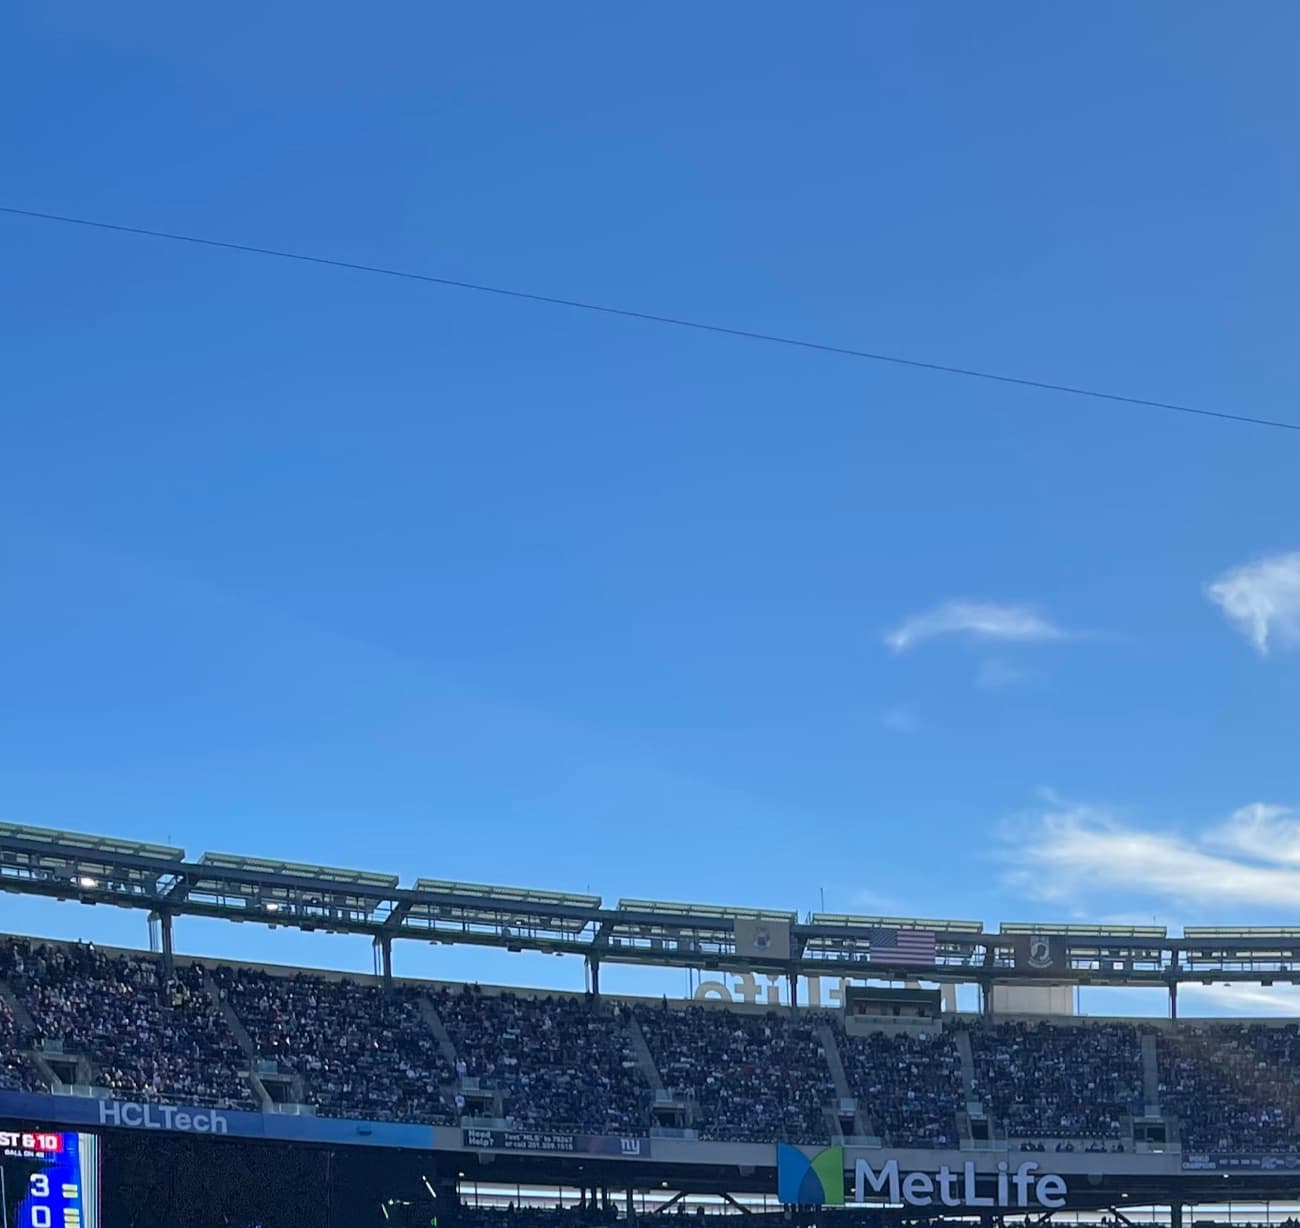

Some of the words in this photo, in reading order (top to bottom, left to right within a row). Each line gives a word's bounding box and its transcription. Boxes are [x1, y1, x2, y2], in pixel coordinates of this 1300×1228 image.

[99, 1100, 228, 1134] HCLTech
[37, 1134, 58, 1149] 10
[468, 1137, 494, 1147] Help?
[621, 1138, 640, 1155] ny
[30, 1173, 49, 1197] 3
[855, 1158, 1068, 1208] MetLife
[31, 1205, 51, 1228] 0
